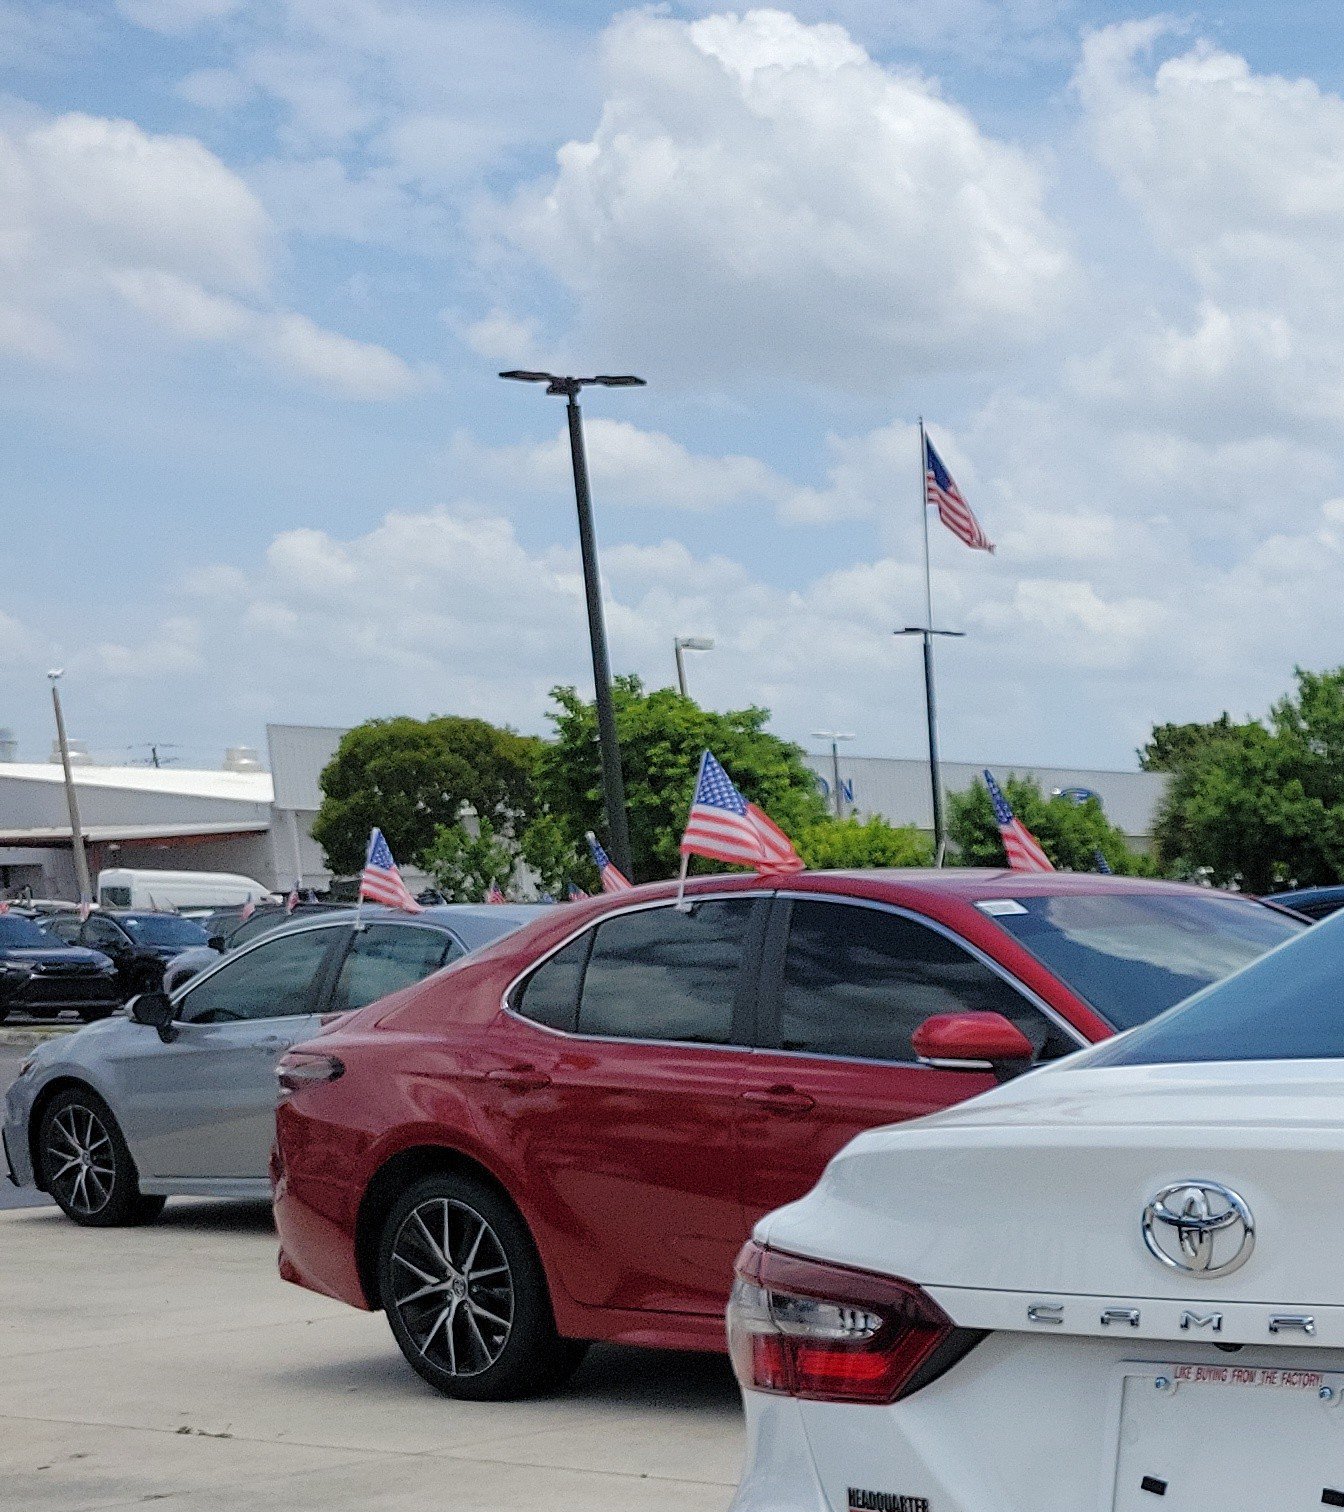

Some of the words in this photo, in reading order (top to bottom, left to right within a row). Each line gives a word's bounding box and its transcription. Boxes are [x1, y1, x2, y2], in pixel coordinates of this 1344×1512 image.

[1174, 1365, 1192, 1380] LIKE
[1195, 1366, 1228, 1382] BUYING
[1231, 1368, 1257, 1384] FROM
[1261, 1370, 1277, 1385] THE
